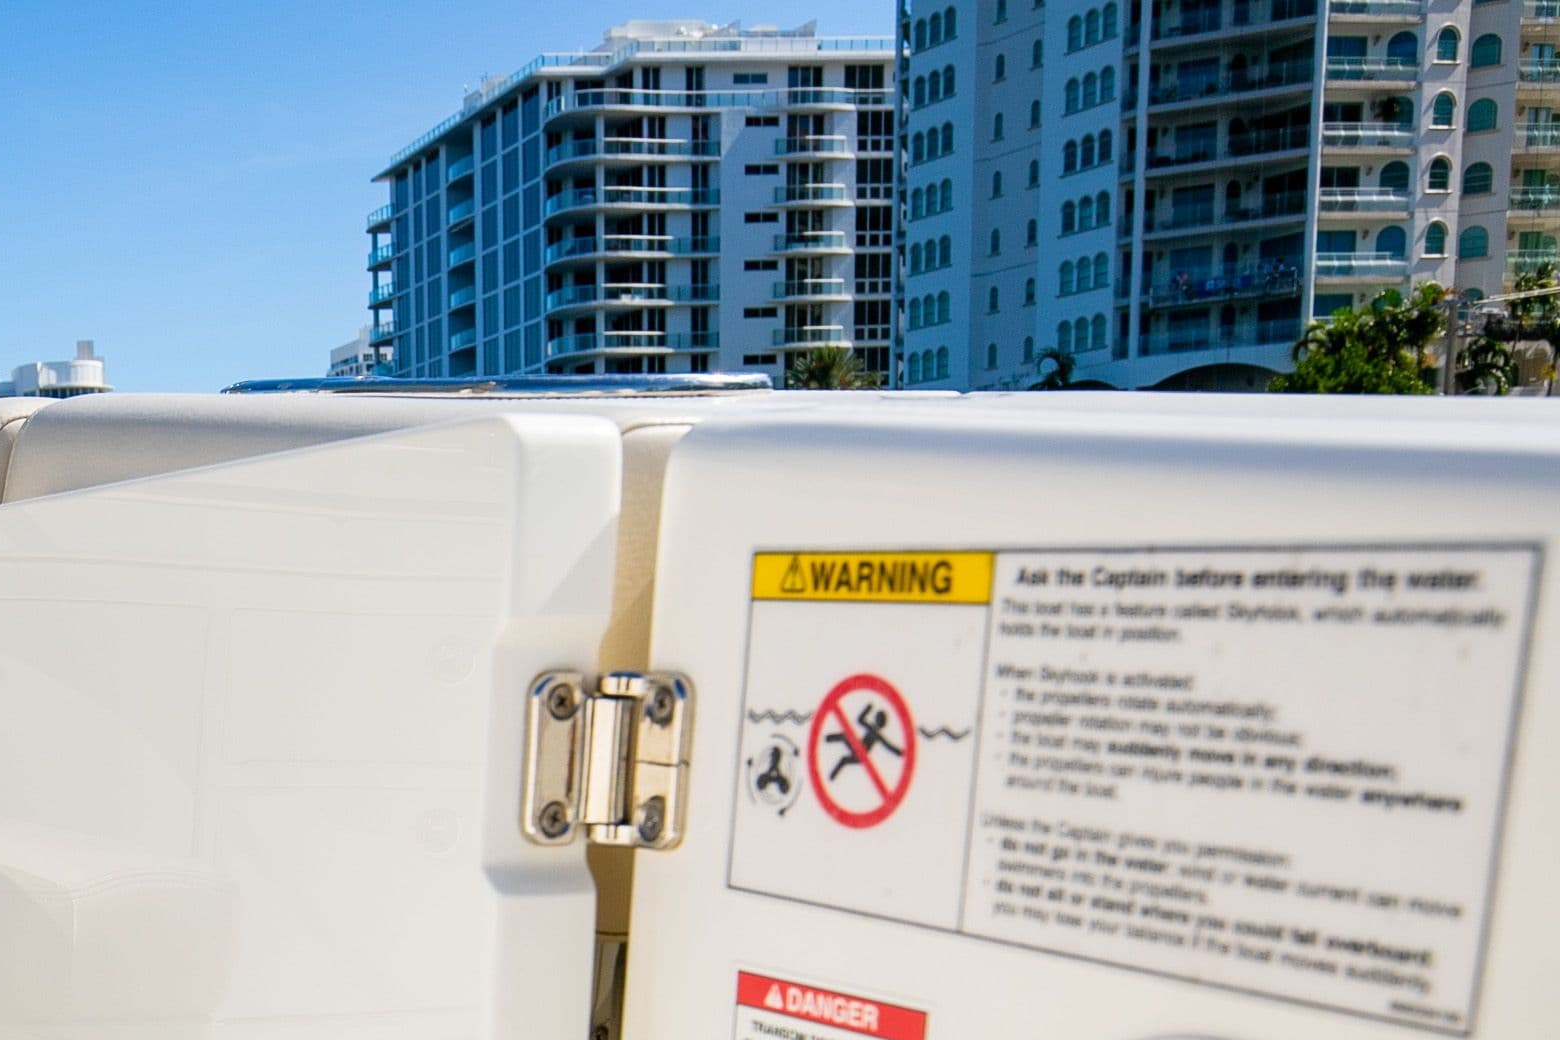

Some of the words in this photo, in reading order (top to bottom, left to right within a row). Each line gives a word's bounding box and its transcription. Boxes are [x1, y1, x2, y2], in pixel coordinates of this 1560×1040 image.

[811, 559, 953, 595] WARNING
[1017, 568, 1049, 585] Ask
[1056, 567, 1085, 585] the
[1093, 567, 1167, 589] Captain
[1175, 569, 1244, 587] before
[1251, 570, 1348, 594] entering
[1357, 569, 1396, 589] the
[1000, 622, 1034, 637] holds
[1041, 622, 1059, 637] the
[1067, 623, 1096, 638] boat
[1002, 599, 1028, 614] This
[1036, 600, 1062, 615] boat
[1071, 601, 1094, 615] has
[1115, 601, 1165, 618] feature
[1174, 603, 1217, 619] called
[1313, 605, 1363, 623] which
[1372, 606, 1506, 629] automatically
[996, 664, 1032, 680] When
[1041, 665, 1099, 685] Skyhook
[1016, 687, 1035, 701] the
[1041, 691, 1110, 709] propellers
[1118, 694, 1159, 711] rotate
[1012, 711, 1072, 728] propeller
[1078, 715, 1132, 731] rotation
[1140, 720, 1169, 737] may
[1178, 722, 1202, 738] not
[1011, 730, 1030, 745] the
[1038, 732, 1065, 748] boat
[1072, 736, 1101, 752] may
[1108, 740, 1181, 761] suddenly
[1189, 748, 1234, 764] move
[1265, 755, 1297, 775] any
[1006, 774, 1052, 792] around
[1058, 778, 1079, 793] the
[1009, 751, 1028, 767] the
[1034, 755, 1104, 775] propellers
[1110, 764, 1134, 778] can
[1141, 764, 1182, 783] injure
[1189, 771, 1243, 792] people
[1272, 777, 1297, 795] the
[1304, 783, 1351, 801] water
[1360, 789, 1463, 812] anywhere
[982, 813, 1025, 831] Unless
[1032, 818, 1051, 834] the
[1057, 820, 1110, 842] Captain
[1117, 832, 1156, 849] gives
[1162, 838, 1189, 855] you
[1001, 836, 1017, 850] do
[1025, 840, 1045, 855] not
[1051, 846, 1068, 861] go
[1077, 848, 1087, 861] in
[1095, 848, 1117, 865] the
[1179, 865, 1214, 882] wind
[1243, 873, 1288, 892] water
[1295, 880, 1361, 901] current
[1367, 892, 1398, 908] can
[1407, 897, 1463, 917] move
[997, 878, 1013, 893] do
[1020, 883, 1041, 898] not
[1048, 886, 1064, 901] sit
[1092, 896, 1133, 914] stand
[1141, 905, 1190, 924] where
[1196, 915, 1226, 931] you
[1234, 920, 1284, 940] could
[1292, 927, 1319, 946] fall
[992, 901, 1016, 916] you
[1023, 905, 1049, 924] may
[1089, 918, 1120, 936] your
[1126, 924, 1184, 946] balance
[1237, 943, 1274, 963] boat
[1280, 952, 1338, 974] moves
[786, 986, 880, 1031] DANGER
